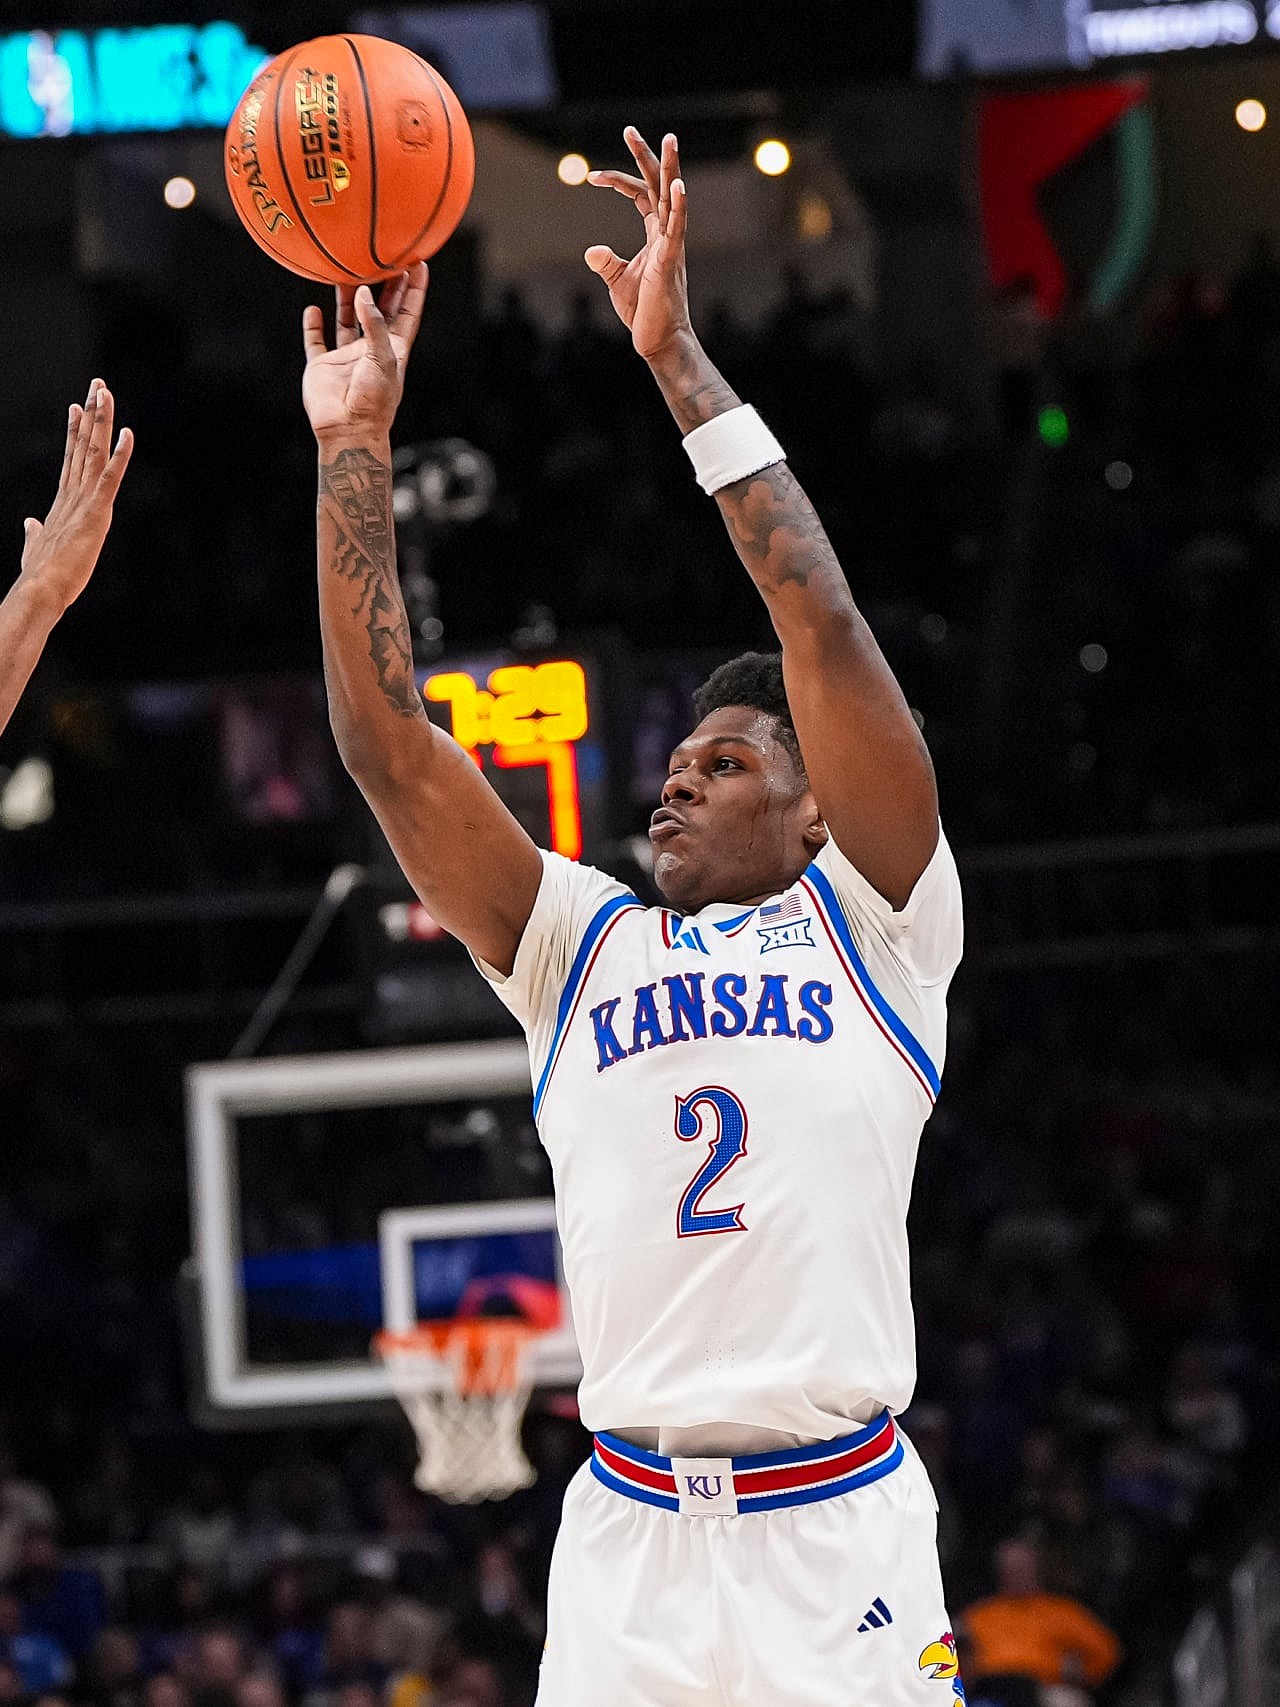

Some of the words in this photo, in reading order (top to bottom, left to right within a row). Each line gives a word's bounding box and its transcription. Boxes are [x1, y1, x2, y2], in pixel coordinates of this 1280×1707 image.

[239, 73, 295, 234] SPALD
[296, 67, 336, 206] LEGACY
[589, 972, 834, 1073] KANSAS
[674, 1085, 748, 1239] 2
[684, 1475, 722, 1499] KU
